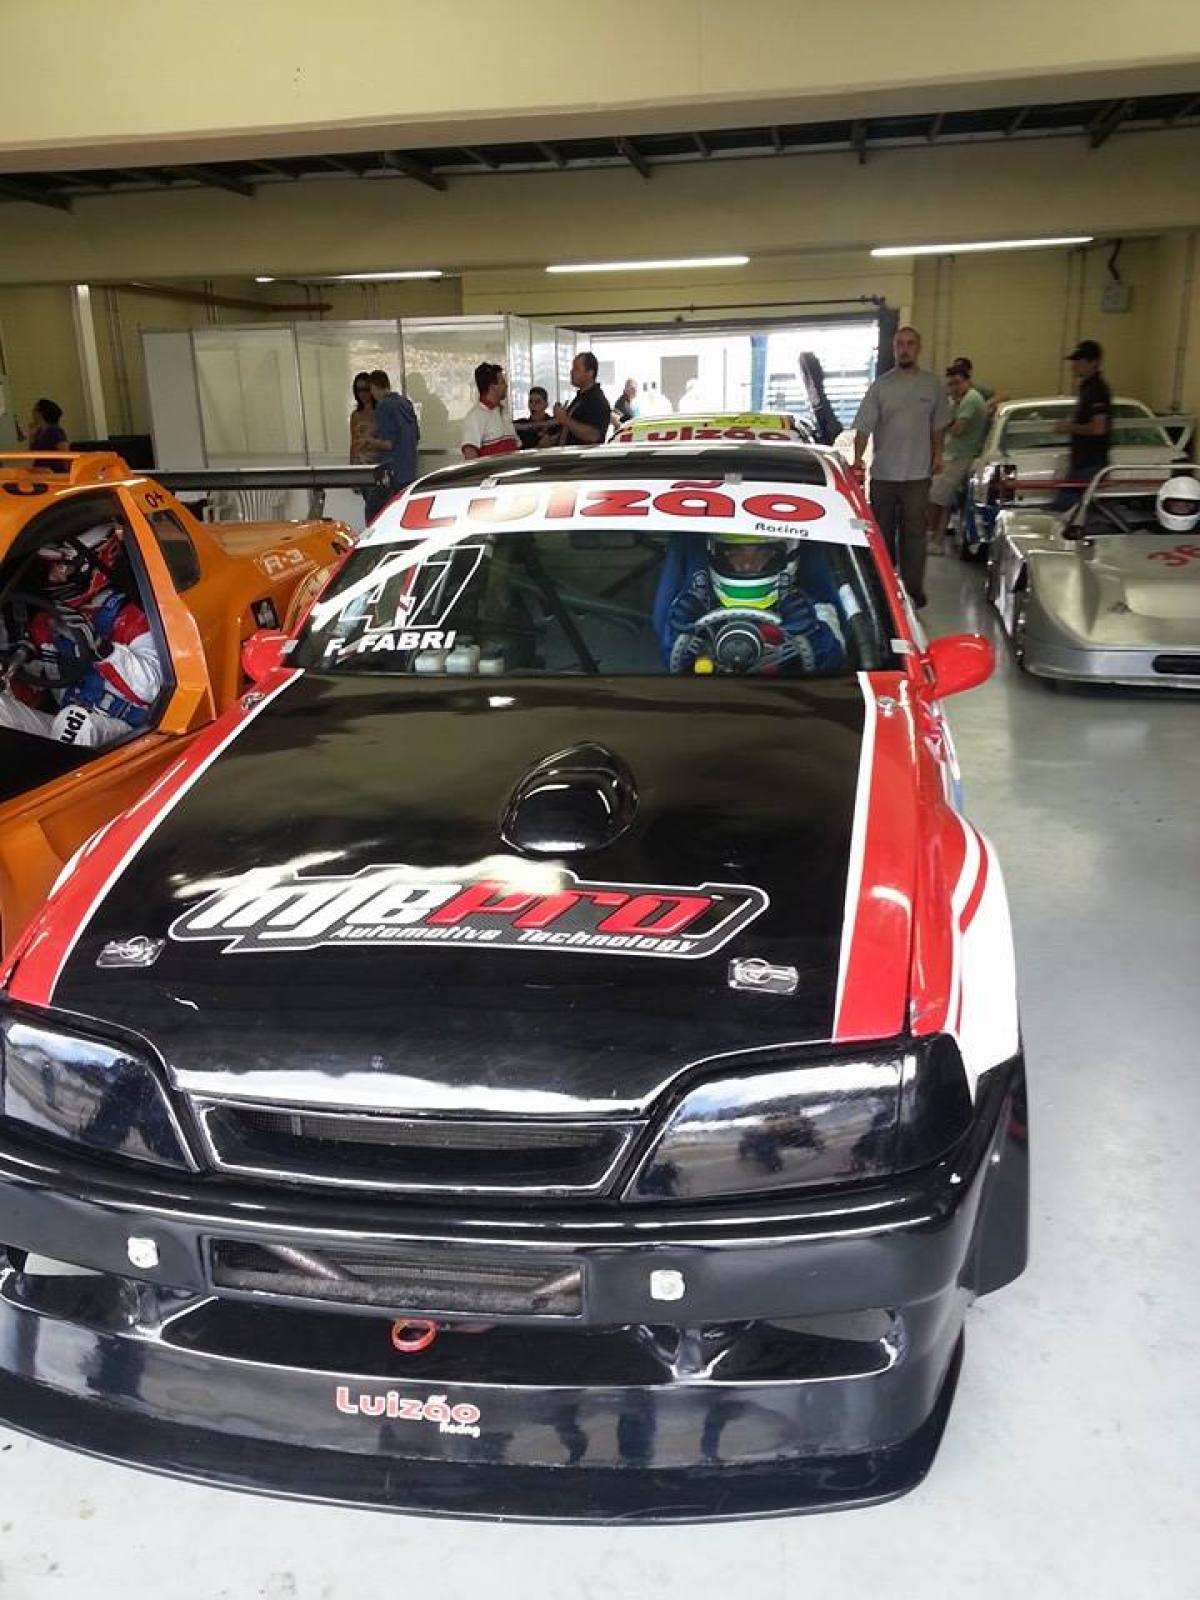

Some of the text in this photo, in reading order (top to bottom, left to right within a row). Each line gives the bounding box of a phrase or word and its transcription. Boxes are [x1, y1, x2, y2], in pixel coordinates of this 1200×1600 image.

[399, 480, 826, 530] Luizão
[754, 522, 810, 538] Racing
[322, 630, 457, 658] F. FABRI
[60, 709, 86, 743] udi
[330, 924, 698, 953] Automotive Technology
[336, 1386, 481, 1423] Luizão
